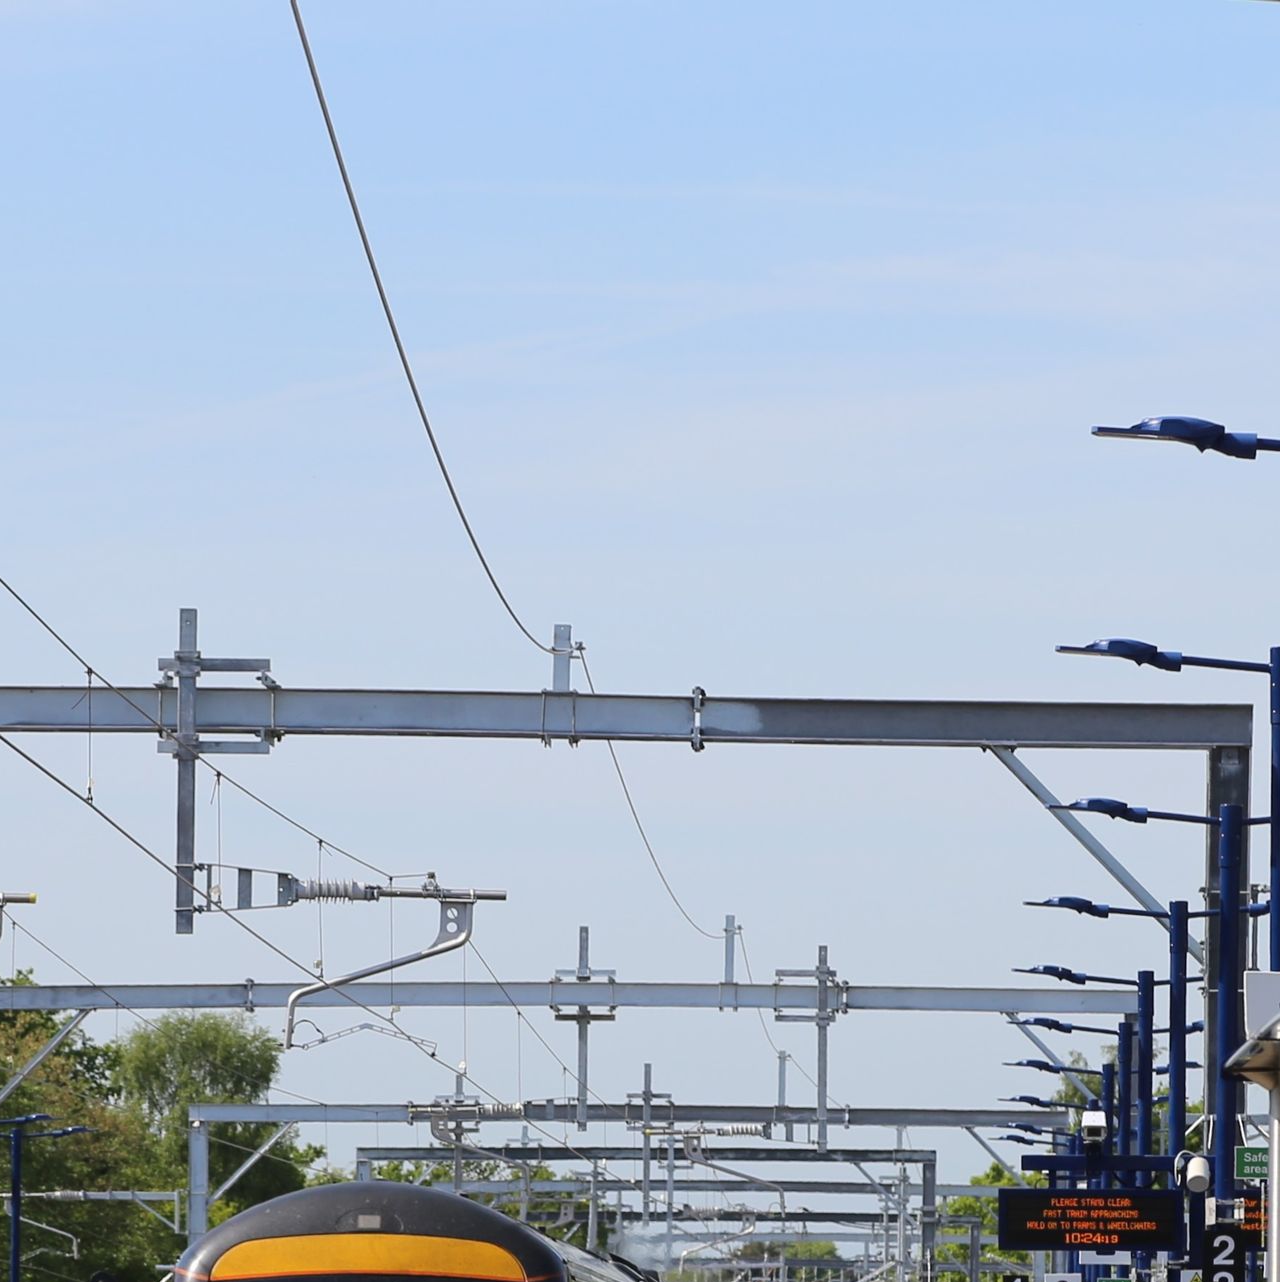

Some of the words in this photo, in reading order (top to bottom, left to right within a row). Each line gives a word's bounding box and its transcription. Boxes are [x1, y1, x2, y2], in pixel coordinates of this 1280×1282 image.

[1243, 1166, 1268, 1174] area
[1051, 1198, 1078, 1207] PLEASE
[1080, 1198, 1105, 1207] STAND
[1107, 1198, 1132, 1207] CLEAR
[1043, 1209, 1061, 1218] FAST
[1066, 1209, 1088, 1218] TRAIN
[1090, 1209, 1139, 1218] APPROACHING
[1026, 1221, 1045, 1230] HOLD
[1060, 1221, 1071, 1230] TO
[1107, 1221, 1157, 1230] WHEELCHAIRS
[1065, 1232, 1119, 1244] 10:24:19
[1213, 1235, 1235, 1265] 2
